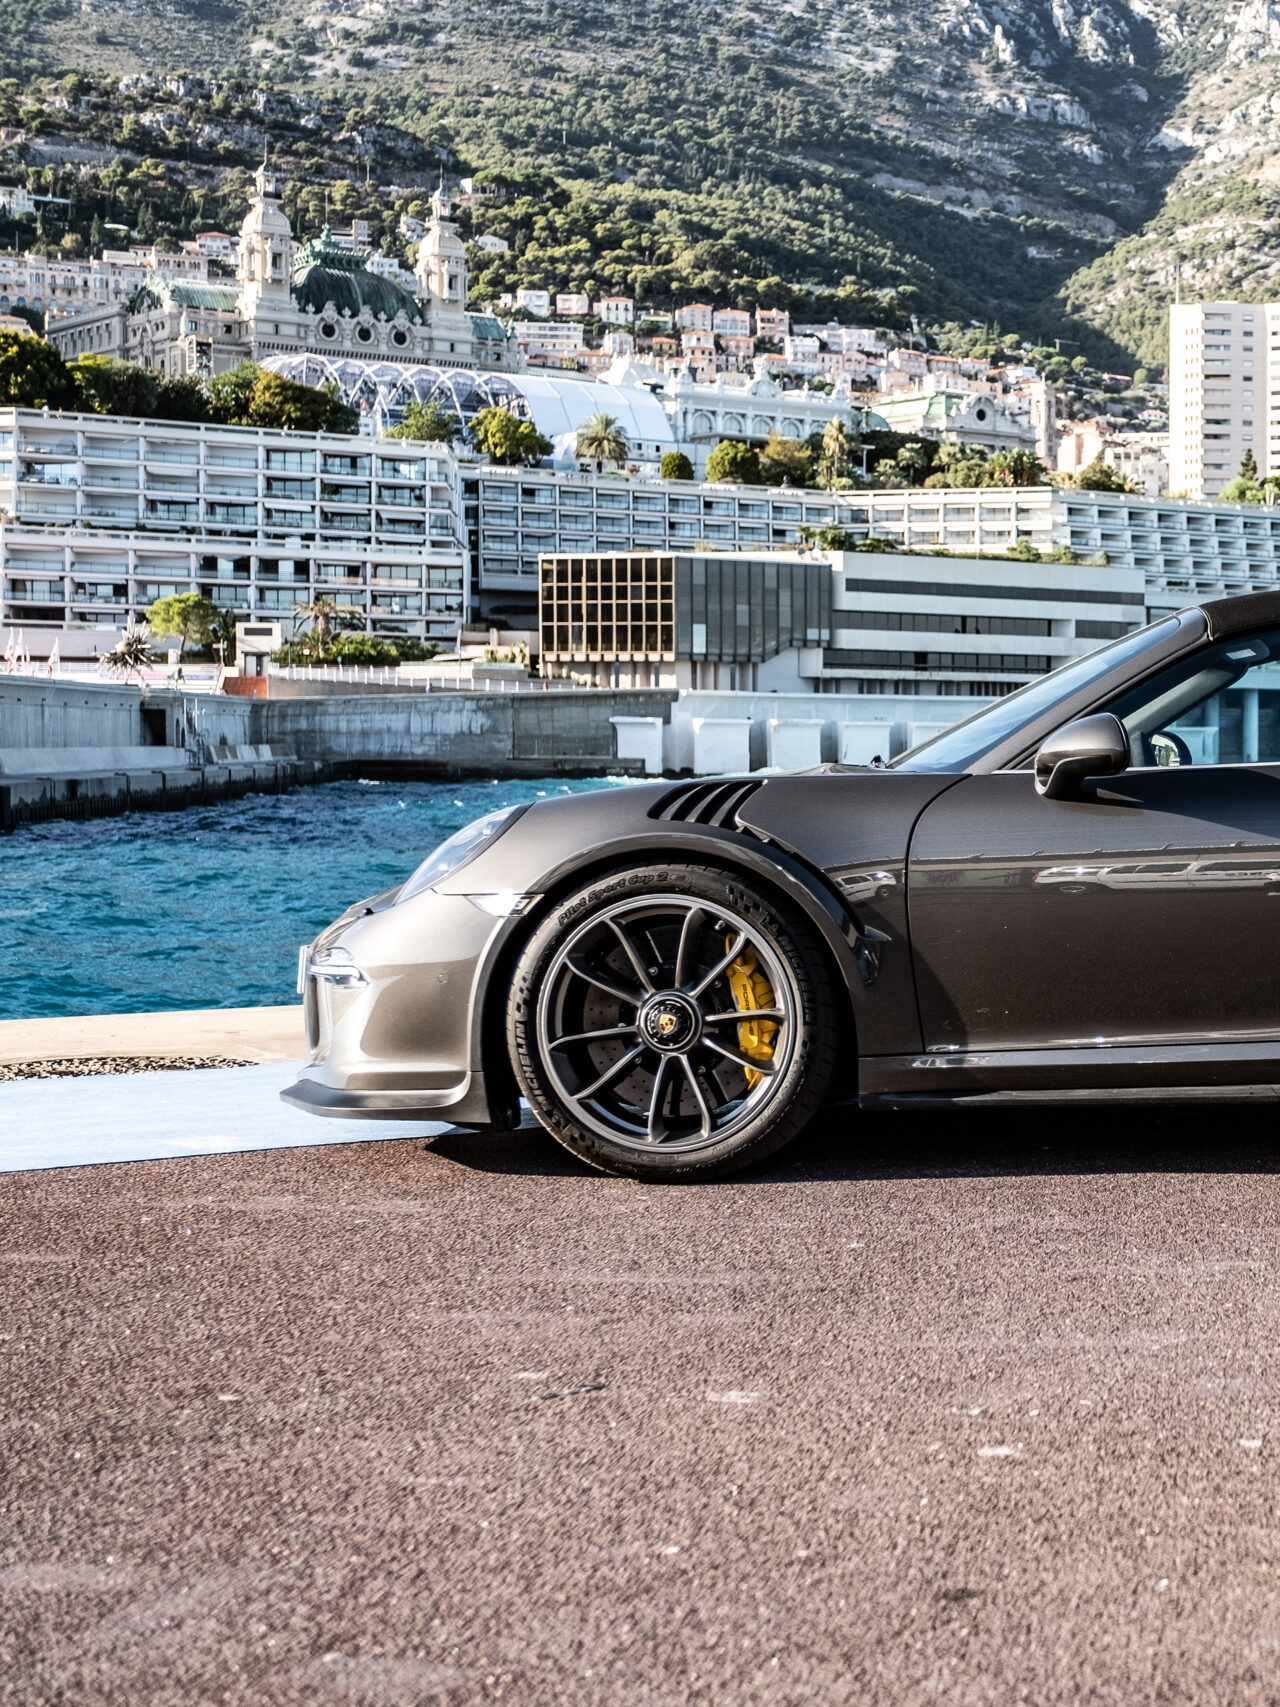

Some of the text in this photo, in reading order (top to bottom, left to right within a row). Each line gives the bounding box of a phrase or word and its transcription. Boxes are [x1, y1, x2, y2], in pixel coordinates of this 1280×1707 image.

[558, 896, 586, 926] Pilot
[588, 878, 627, 904] Sport
[628, 874, 654, 886] Cup
[656, 871, 669, 881] 2
[777, 933, 815, 1021] MICHELIN
[515, 1022, 553, 1112] MICHELIN
